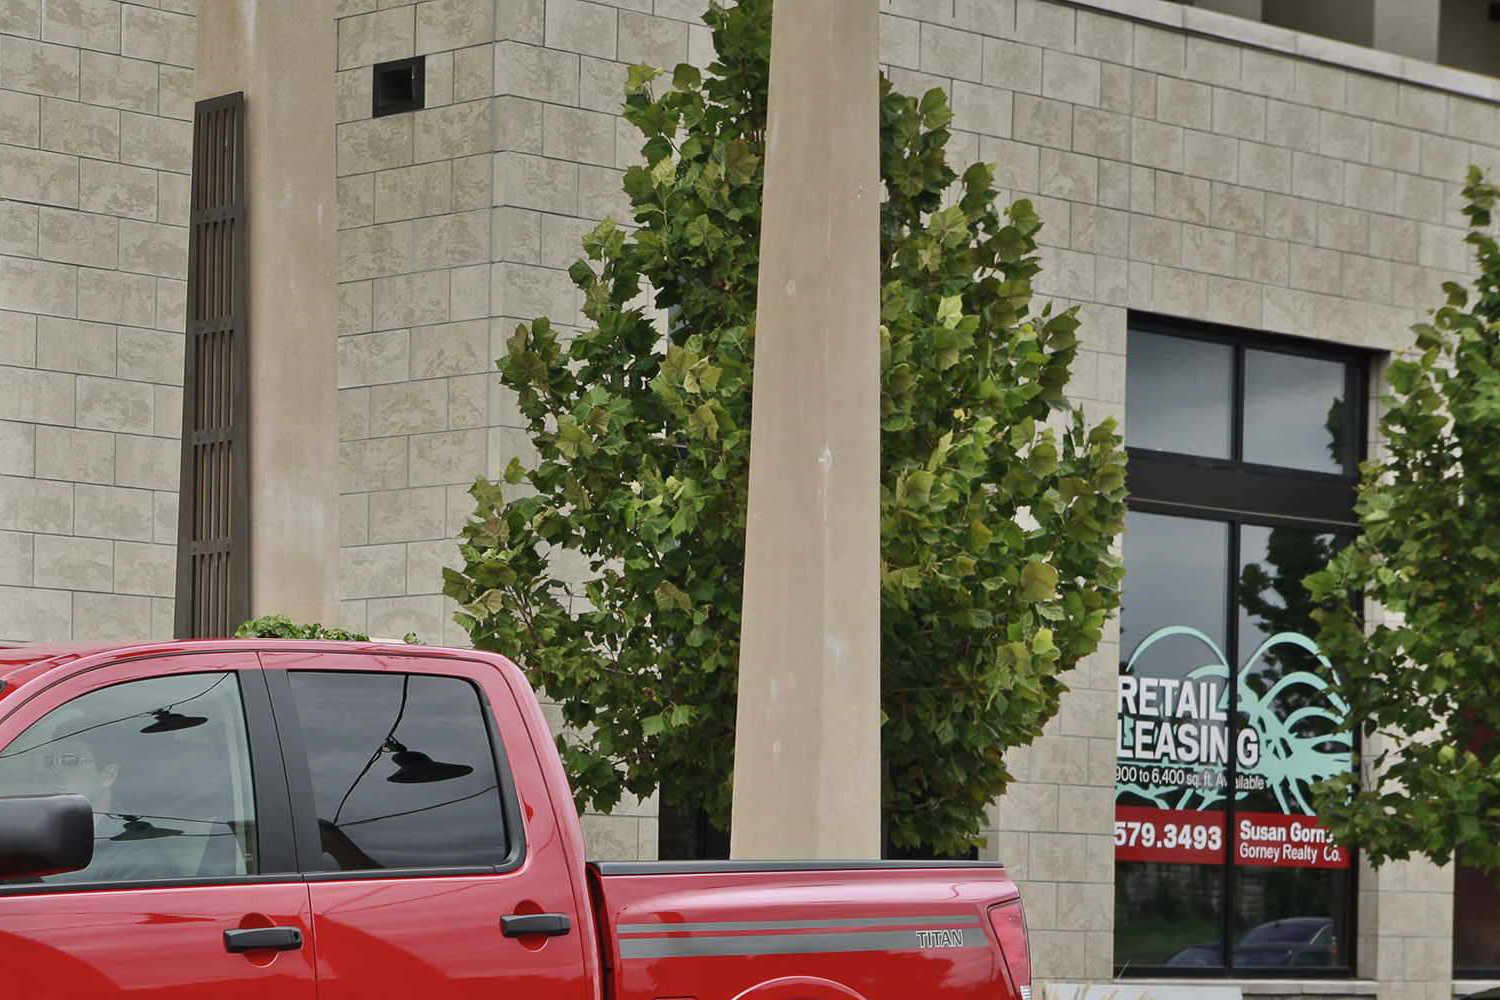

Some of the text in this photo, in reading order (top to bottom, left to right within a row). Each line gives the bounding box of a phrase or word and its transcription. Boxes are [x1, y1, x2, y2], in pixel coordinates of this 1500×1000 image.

[1118, 675, 1228, 721] RETAIL
[1116, 719, 1260, 766] LEASING
[1138, 768, 1150, 783] to
[1151, 768, 1184, 786] 6,400
[1186, 773, 1202, 789] sq.
[1203, 770, 1214, 787] ft.
[1114, 820, 1222, 851] 579.3493
[1239, 819, 1335, 844] Susan Gorn
[1239, 841, 1342, 864] Gorney Realty Co.
[915, 929, 964, 949] TITAN
